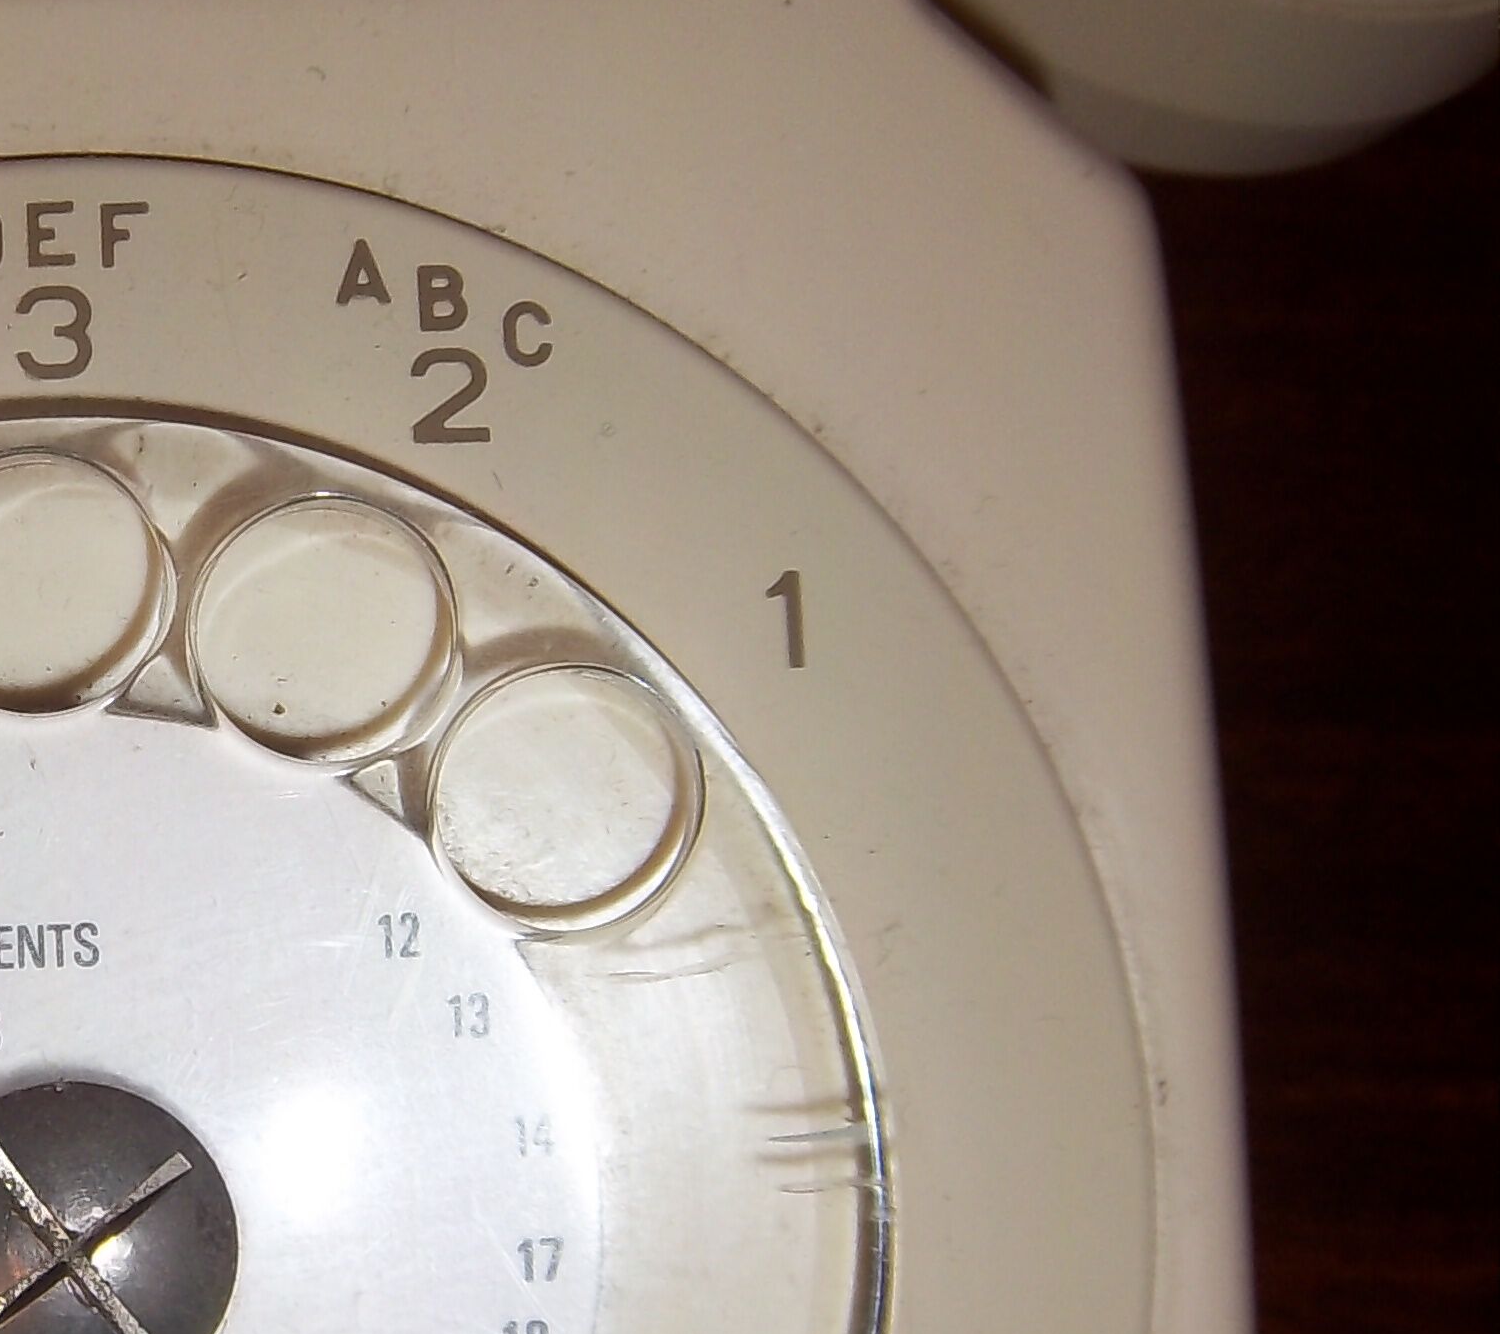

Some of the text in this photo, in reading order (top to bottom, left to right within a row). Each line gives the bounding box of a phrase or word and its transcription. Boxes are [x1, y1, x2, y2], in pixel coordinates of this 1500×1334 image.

[15, 285, 93, 380] 3
[409, 347, 492, 445] 2
[764, 569, 805, 669] 1
[376, 910, 422, 960] 12
[446, 991, 491, 1040] 13
[516, 1237, 565, 1283] 17
